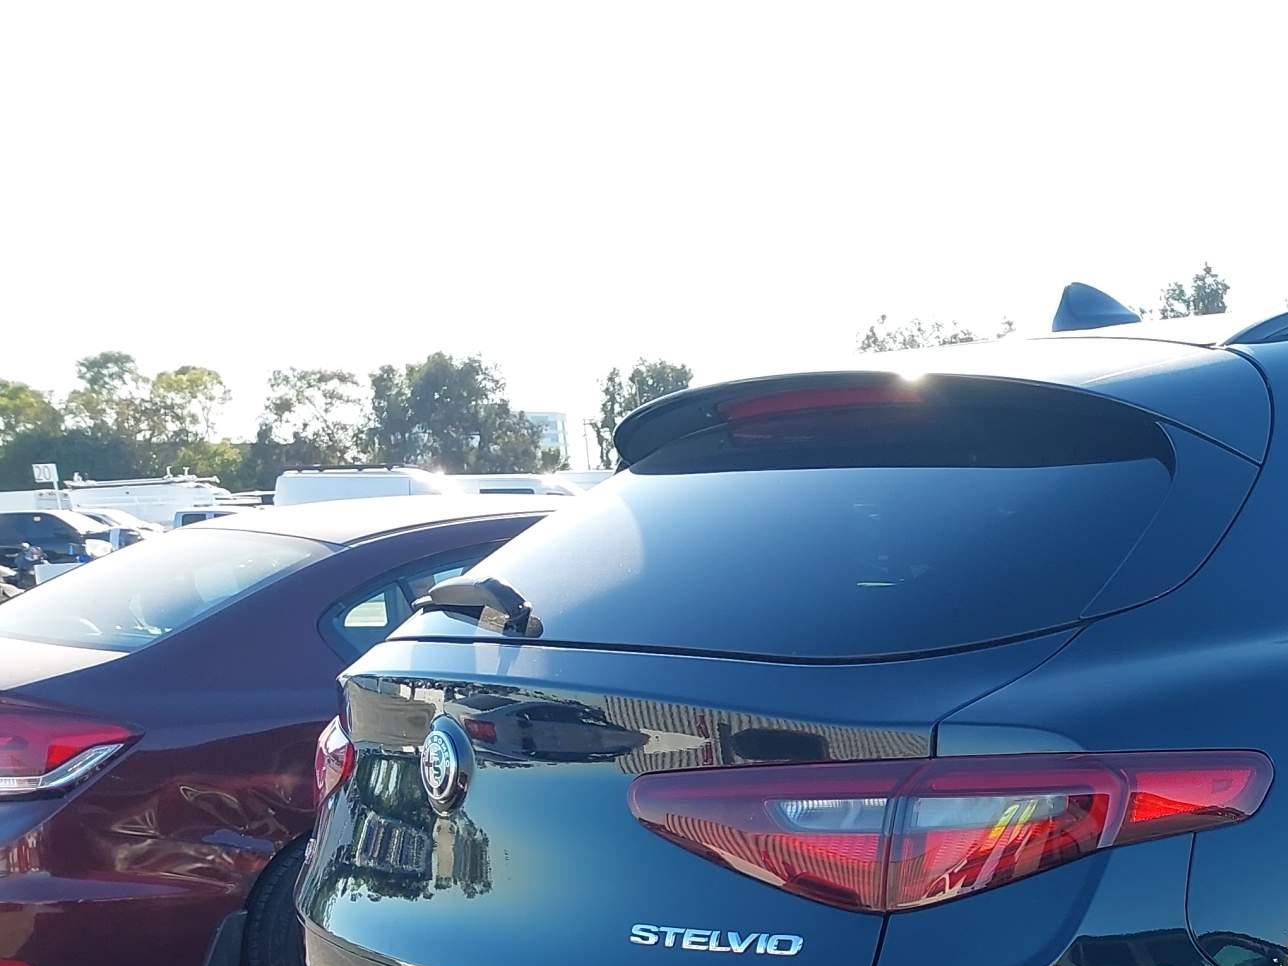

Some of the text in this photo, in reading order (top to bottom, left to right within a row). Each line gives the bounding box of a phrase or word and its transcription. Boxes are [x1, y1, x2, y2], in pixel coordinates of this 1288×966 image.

[34, 465, 52, 481] 20
[433, 735, 450, 768] ROMEO
[629, 923, 804, 956] STELVIO
